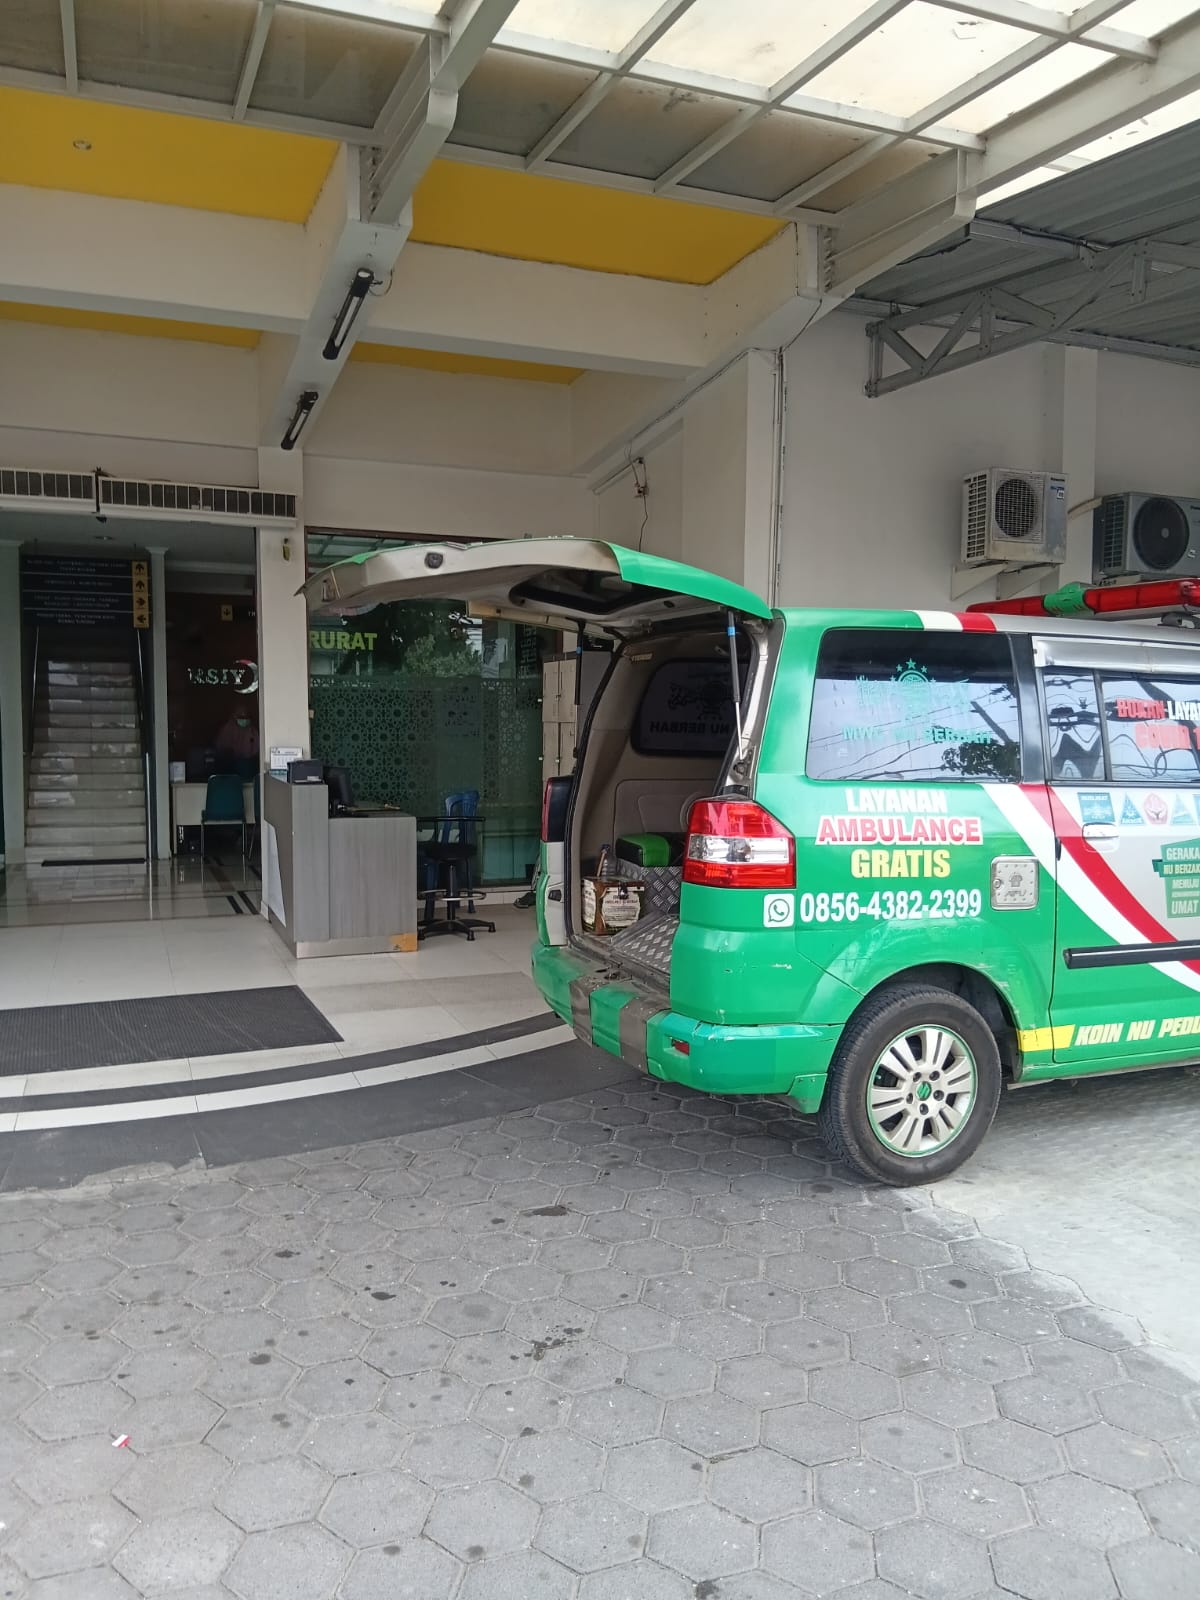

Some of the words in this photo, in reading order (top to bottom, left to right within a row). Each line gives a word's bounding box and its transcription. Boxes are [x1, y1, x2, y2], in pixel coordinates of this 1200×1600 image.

[309, 630, 378, 651] RURAT
[846, 787, 949, 814] LAYANAN
[816, 816, 983, 844] AMBULANCE
[850, 849, 951, 879] GRATIS
[800, 889, 982, 923] 0856-4382-2399
[1171, 899, 1199, 915] UMAT
[1074, 1022, 1125, 1047] KOIN
[1126, 1019, 1157, 1042] NU
